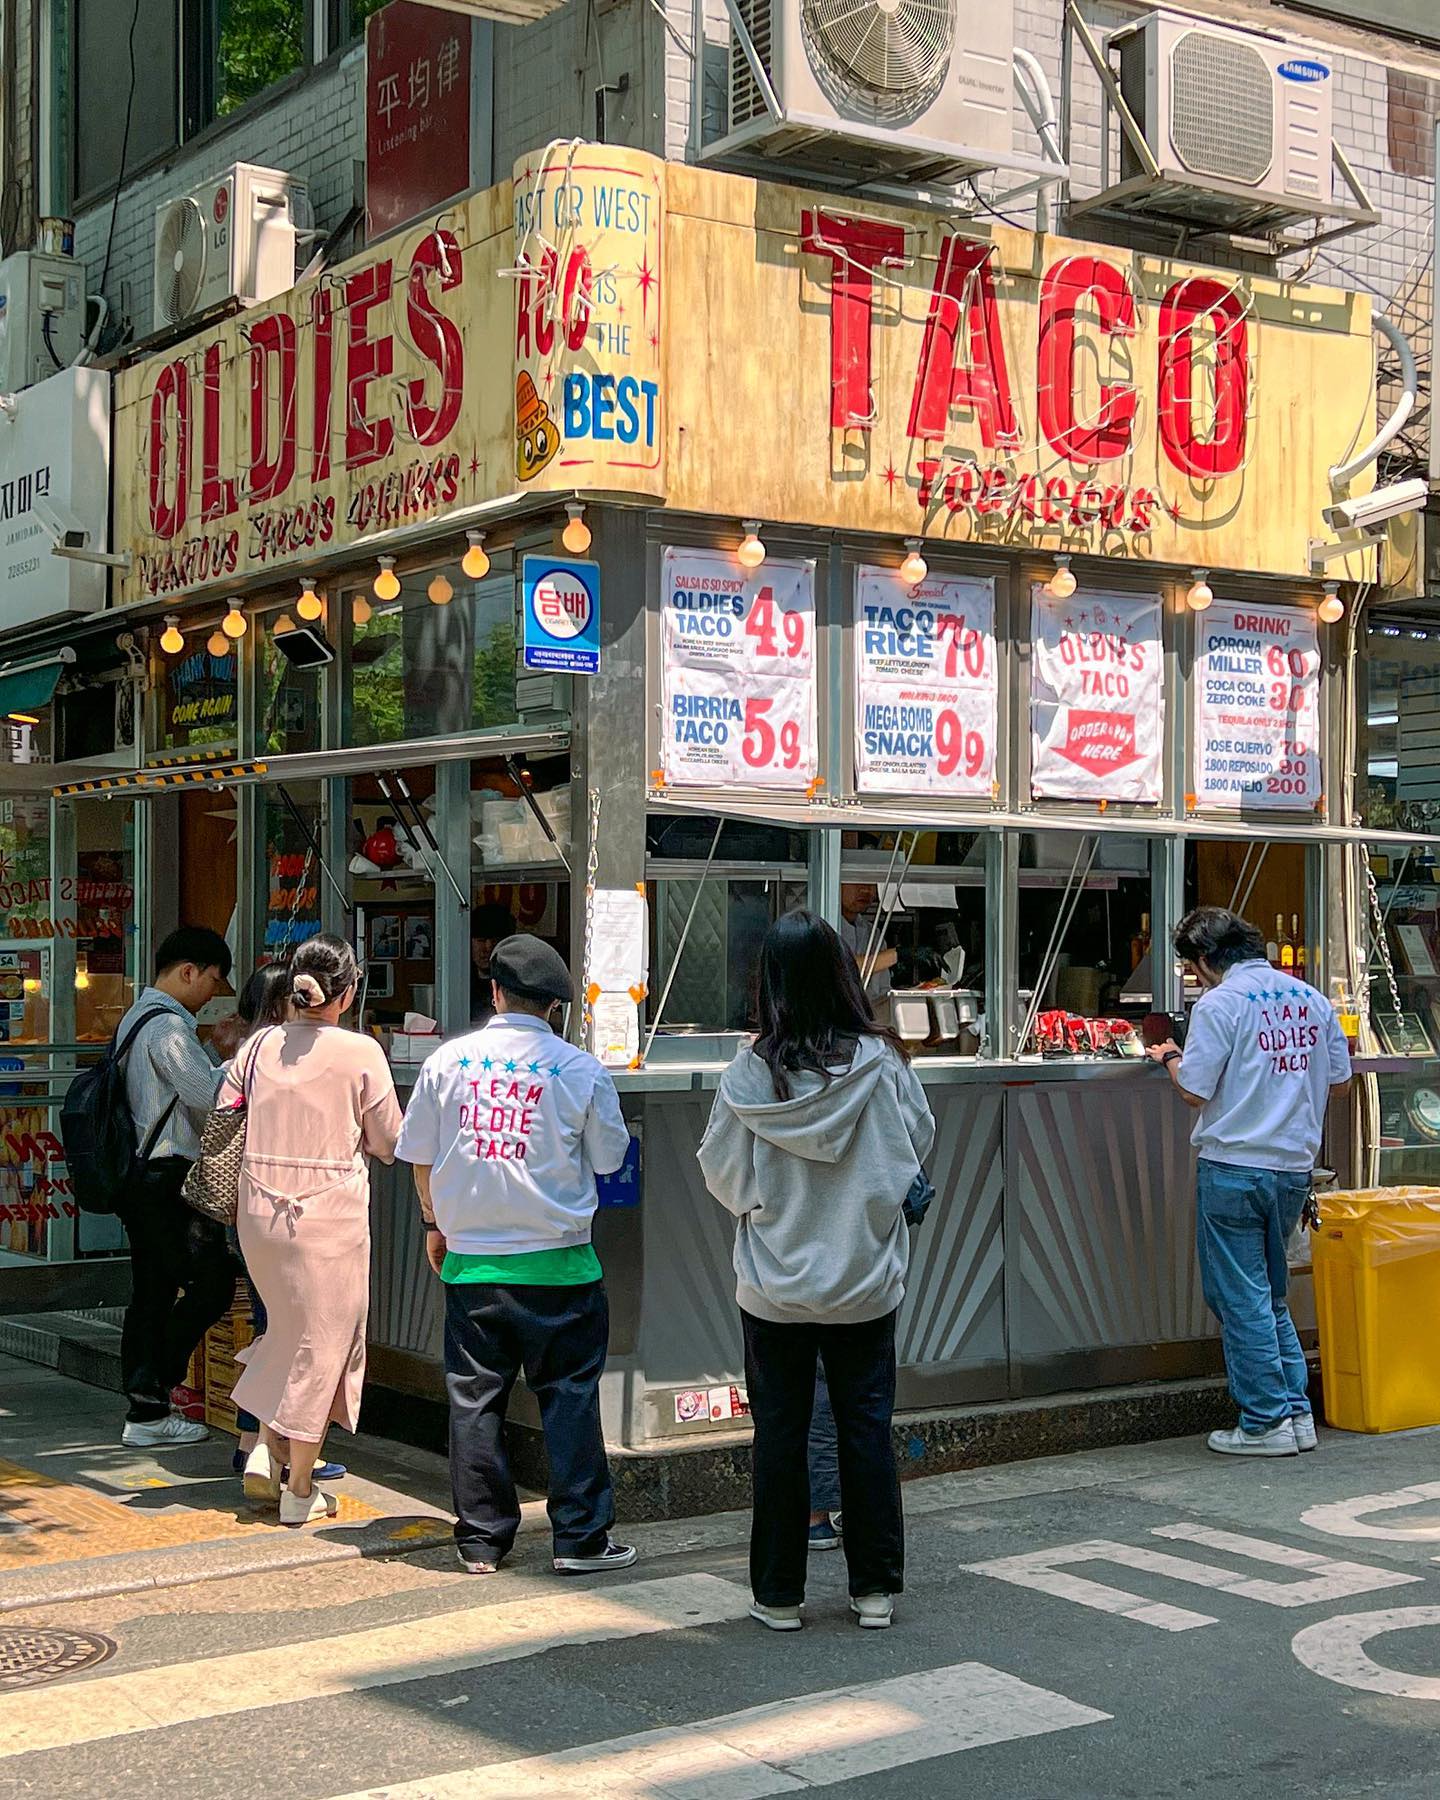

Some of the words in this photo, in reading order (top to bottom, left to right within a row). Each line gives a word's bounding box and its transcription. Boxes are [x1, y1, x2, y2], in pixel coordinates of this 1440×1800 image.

[1283, 62, 1325, 81] SAMSUNG
[593, 185, 651, 236] WEST
[214, 227, 227, 250] LG
[596, 270, 617, 305] IS
[514, 244, 594, 361] ACO
[595, 321, 632, 357] THE
[801, 208, 1250, 480] TACO
[146, 229, 464, 541] OLDIES
[563, 372, 658, 448] BEST
[675, 575, 700, 590] SALSA
[701, 577, 710, 590] IS
[710, 578, 722, 591] SO
[722, 579, 744, 593] SPICY
[906, 583, 948, 600] Special
[539, 589, 586, 619] 담배
[672, 590, 744, 618] OLDIES
[675, 613, 732, 637] TACO
[745, 586, 805, 658] 4.9
[864, 605, 934, 631] TACO
[1233, 613, 1291, 637] DRINK!
[865, 630, 934, 658] RICE
[937, 613, 984, 678] 7.0
[1059, 632, 1147, 672] OLDIES
[1208, 635, 1262, 656] CORONA
[1208, 655, 1263, 675] MILLER
[1080, 670, 1130, 698] TACO
[1206, 679, 1236, 692] COCA
[1237, 681, 1266, 694] COLA
[172, 701, 199, 725] COME
[200, 694, 233, 719] AGAIN
[673, 694, 744, 722] BIRRIA
[1206, 693, 1235, 705] ZERO
[1237, 695, 1266, 707] COKE
[865, 704, 899, 731] MEGA
[900, 706, 934, 733] BOMB
[1218, 714, 1253, 726] TEQUILA
[1253, 717, 1272, 728] ONLY
[675, 720, 729, 745] TACO
[742, 697, 800, 769] 5.9
[864, 731, 934, 757] SNACK
[936, 709, 984, 777] 9.9
[1070, 722, 1107, 742] ORDER
[1081, 744, 1123, 761] HERE
[1205, 739, 1233, 753] JOSE
[1233, 740, 1273, 755] CUERVO
[1204, 759, 1228, 772] 1800
[1228, 760, 1273, 774] REPOSADO
[1204, 778, 1229, 791] 1800
[1258, 1025, 1319, 1052] OLDIES
[1271, 1054, 1308, 1074] TACO
[467, 1079, 544, 1105] TEAM
[459, 1104, 533, 1135] OLDIE
[474, 1138, 527, 1161] TACO
